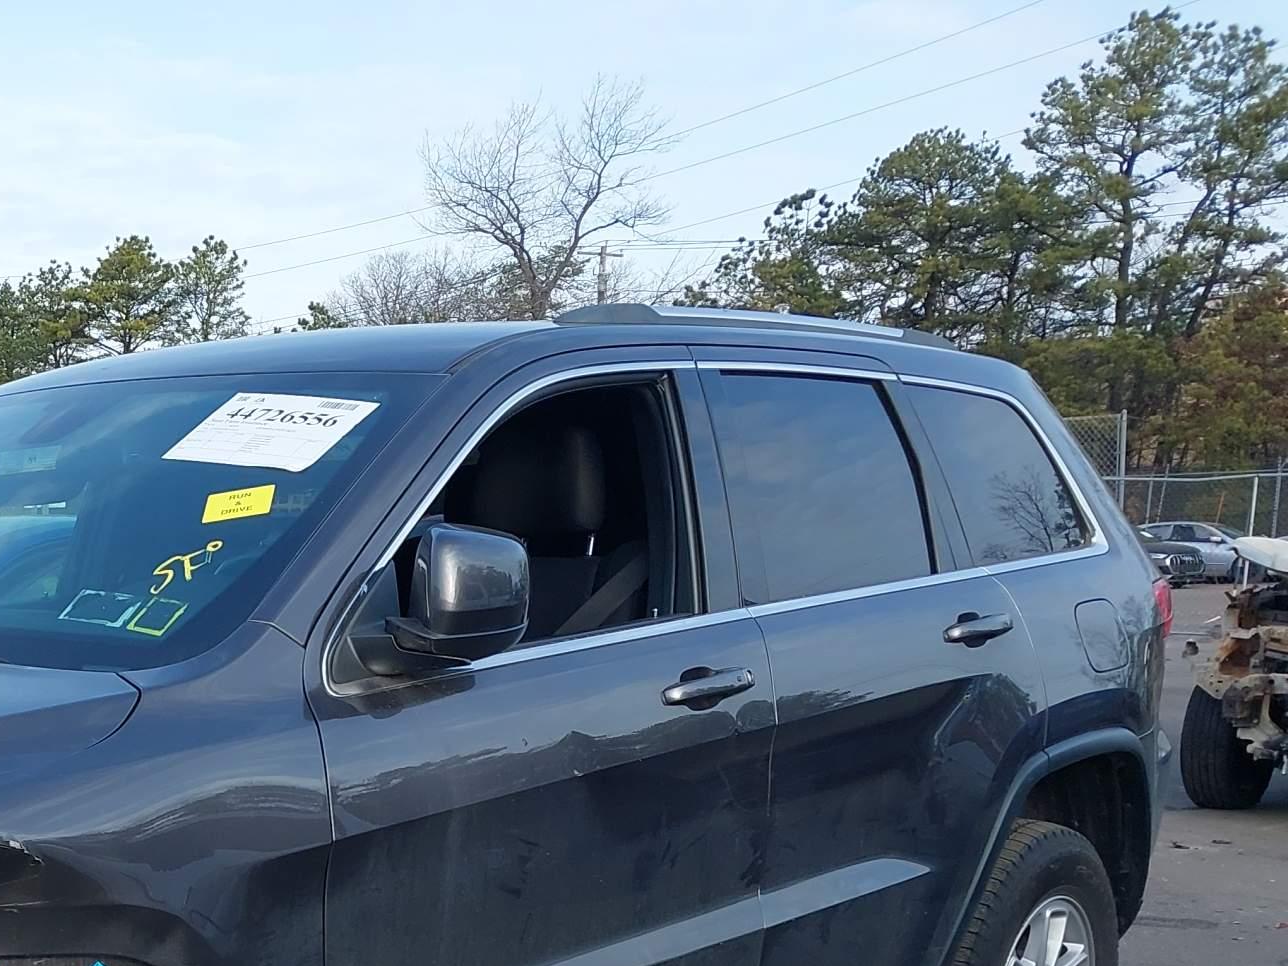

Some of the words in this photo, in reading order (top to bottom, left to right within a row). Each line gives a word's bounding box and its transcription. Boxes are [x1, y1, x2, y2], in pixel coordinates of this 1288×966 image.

[226, 406, 344, 427] 44726556
[228, 492, 252, 500] RUN
[221, 505, 253, 515] DRIVE
